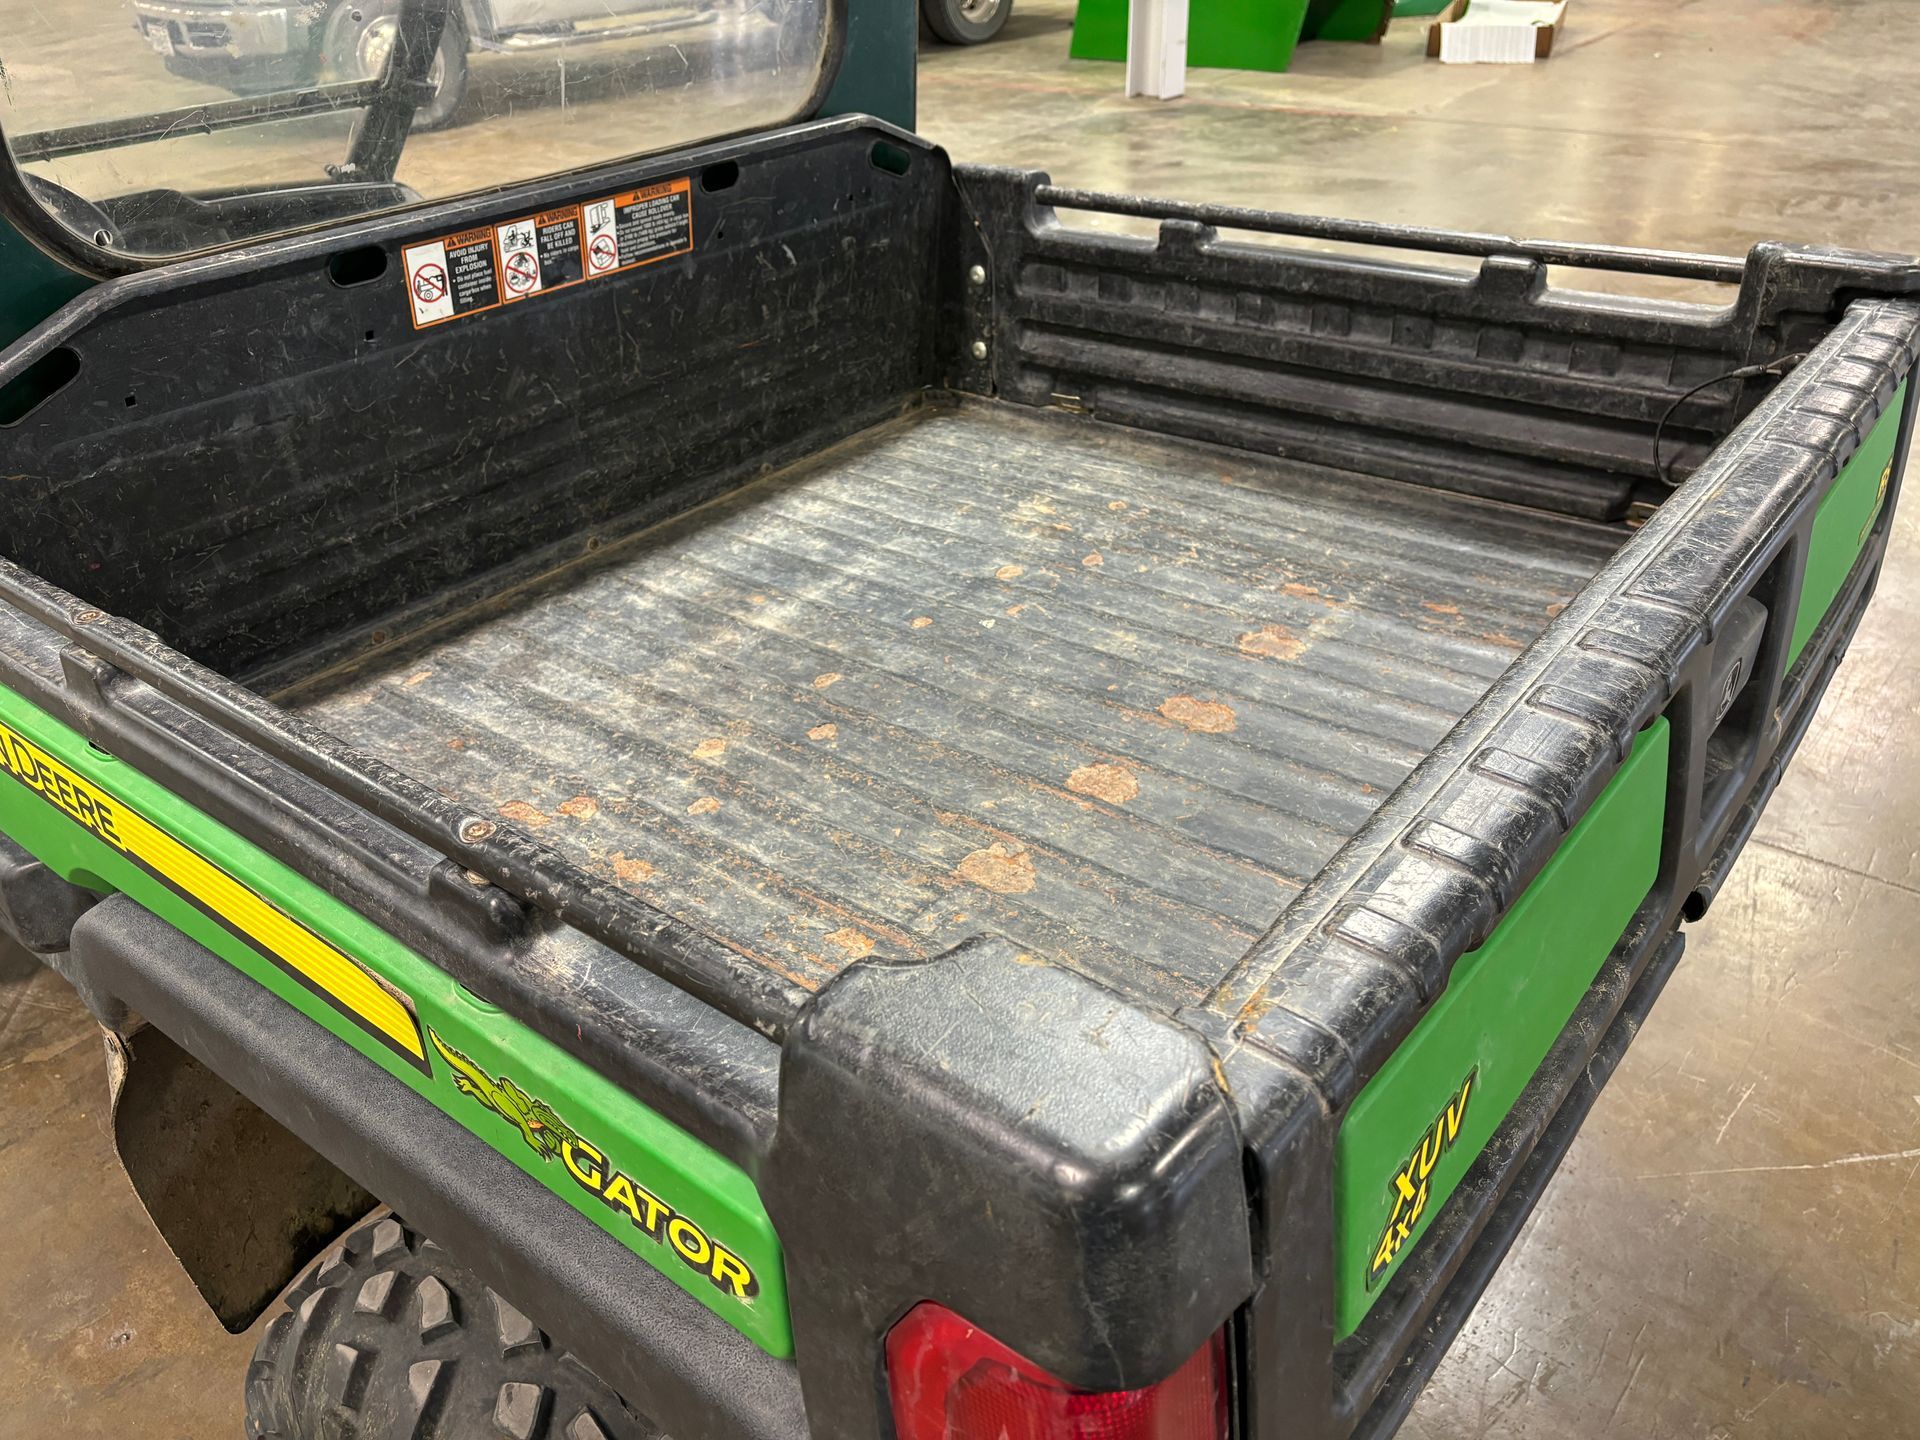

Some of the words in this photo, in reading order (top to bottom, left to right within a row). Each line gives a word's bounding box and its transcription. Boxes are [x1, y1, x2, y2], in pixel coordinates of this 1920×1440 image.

[640, 184, 672, 198] WARNING
[548, 206, 577, 221] WARNING
[632, 210, 647, 219] CAUSE
[542, 224, 562, 234] RIDERS
[563, 221, 574, 229] CAN
[457, 228, 491, 243] WARNING
[541, 234, 553, 243] FALL
[565, 229, 576, 237] AND
[547, 242, 554, 250] BE
[555, 237, 573, 248] KILLED
[449, 248, 467, 259] AVOID
[468, 243, 489, 255] INJURY
[461, 254, 478, 264] FROM
[455, 260, 487, 274] EXPLOSION
[8, 733, 123, 845] DEERE
[1390, 1077, 1472, 1226] XUV
[561, 1137, 755, 1299] GATOR
